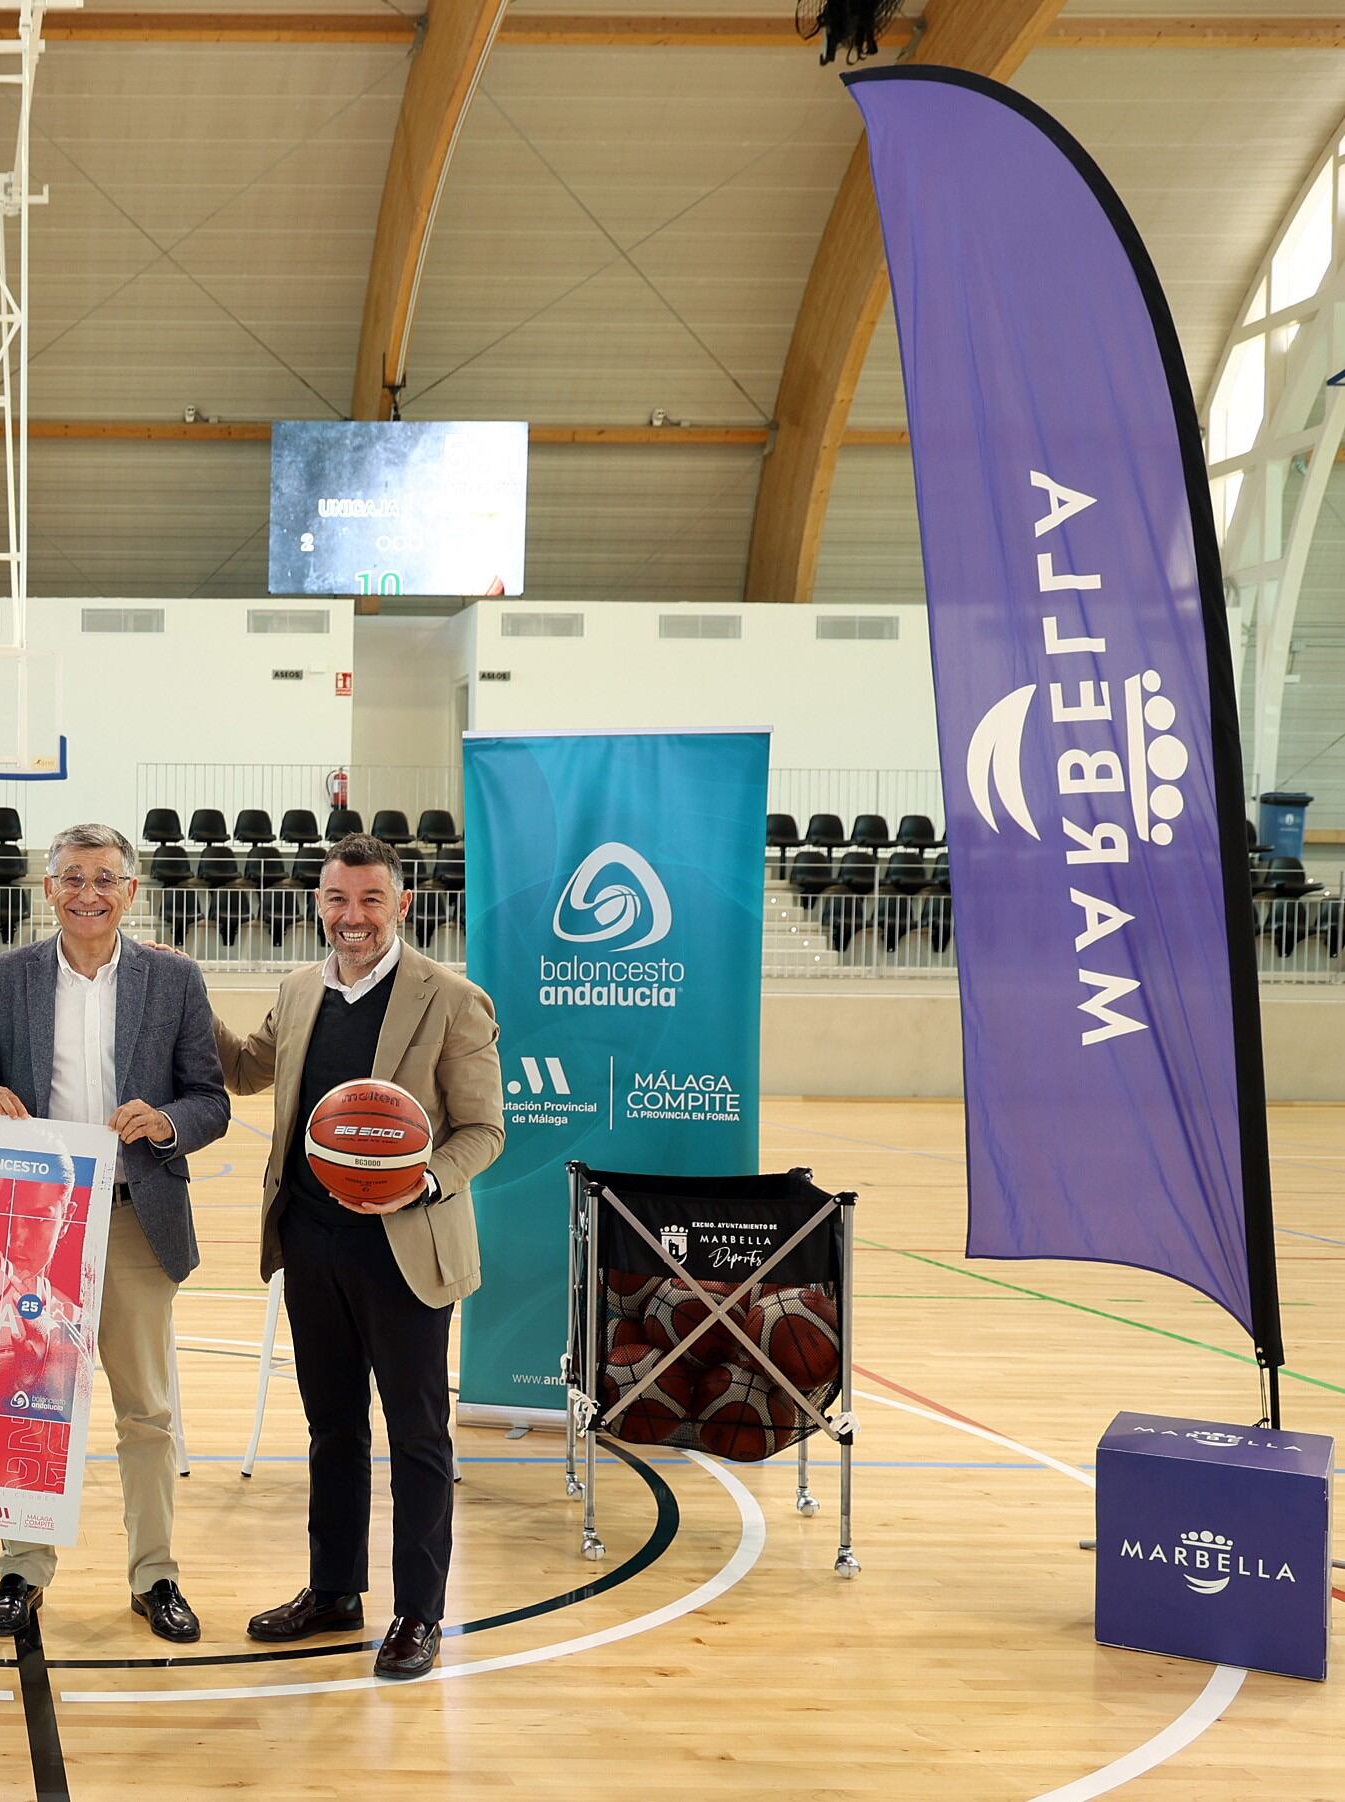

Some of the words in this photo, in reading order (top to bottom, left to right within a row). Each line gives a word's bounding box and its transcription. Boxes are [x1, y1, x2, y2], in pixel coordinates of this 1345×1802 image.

[274, 670, 300, 679] ASEOS
[540, 954, 685, 982] baloncesto
[539, 982, 676, 1007] andalucía
[634, 1069, 732, 1092] MÁLAGA
[342, 1091, 401, 1108] molten
[627, 1091, 741, 1112] COMPITE
[502, 1101, 542, 1112] utación
[544, 1101, 597, 1113] Provincial
[511, 1113, 526, 1124] de
[528, 1113, 568, 1126] Málaga
[627, 1110, 639, 1118] LA
[640, 1111, 690, 1120] PROVINCIA
[692, 1112, 705, 1121] EN
[706, 1112, 740, 1122] FORMA
[717, 1222, 768, 1230] AYUNTAMIENTO
[699, 1235, 772, 1246] MARBELLA
[21, 1301, 39, 1313] 25
[1120, 1538, 1296, 1583] MARBELLA
